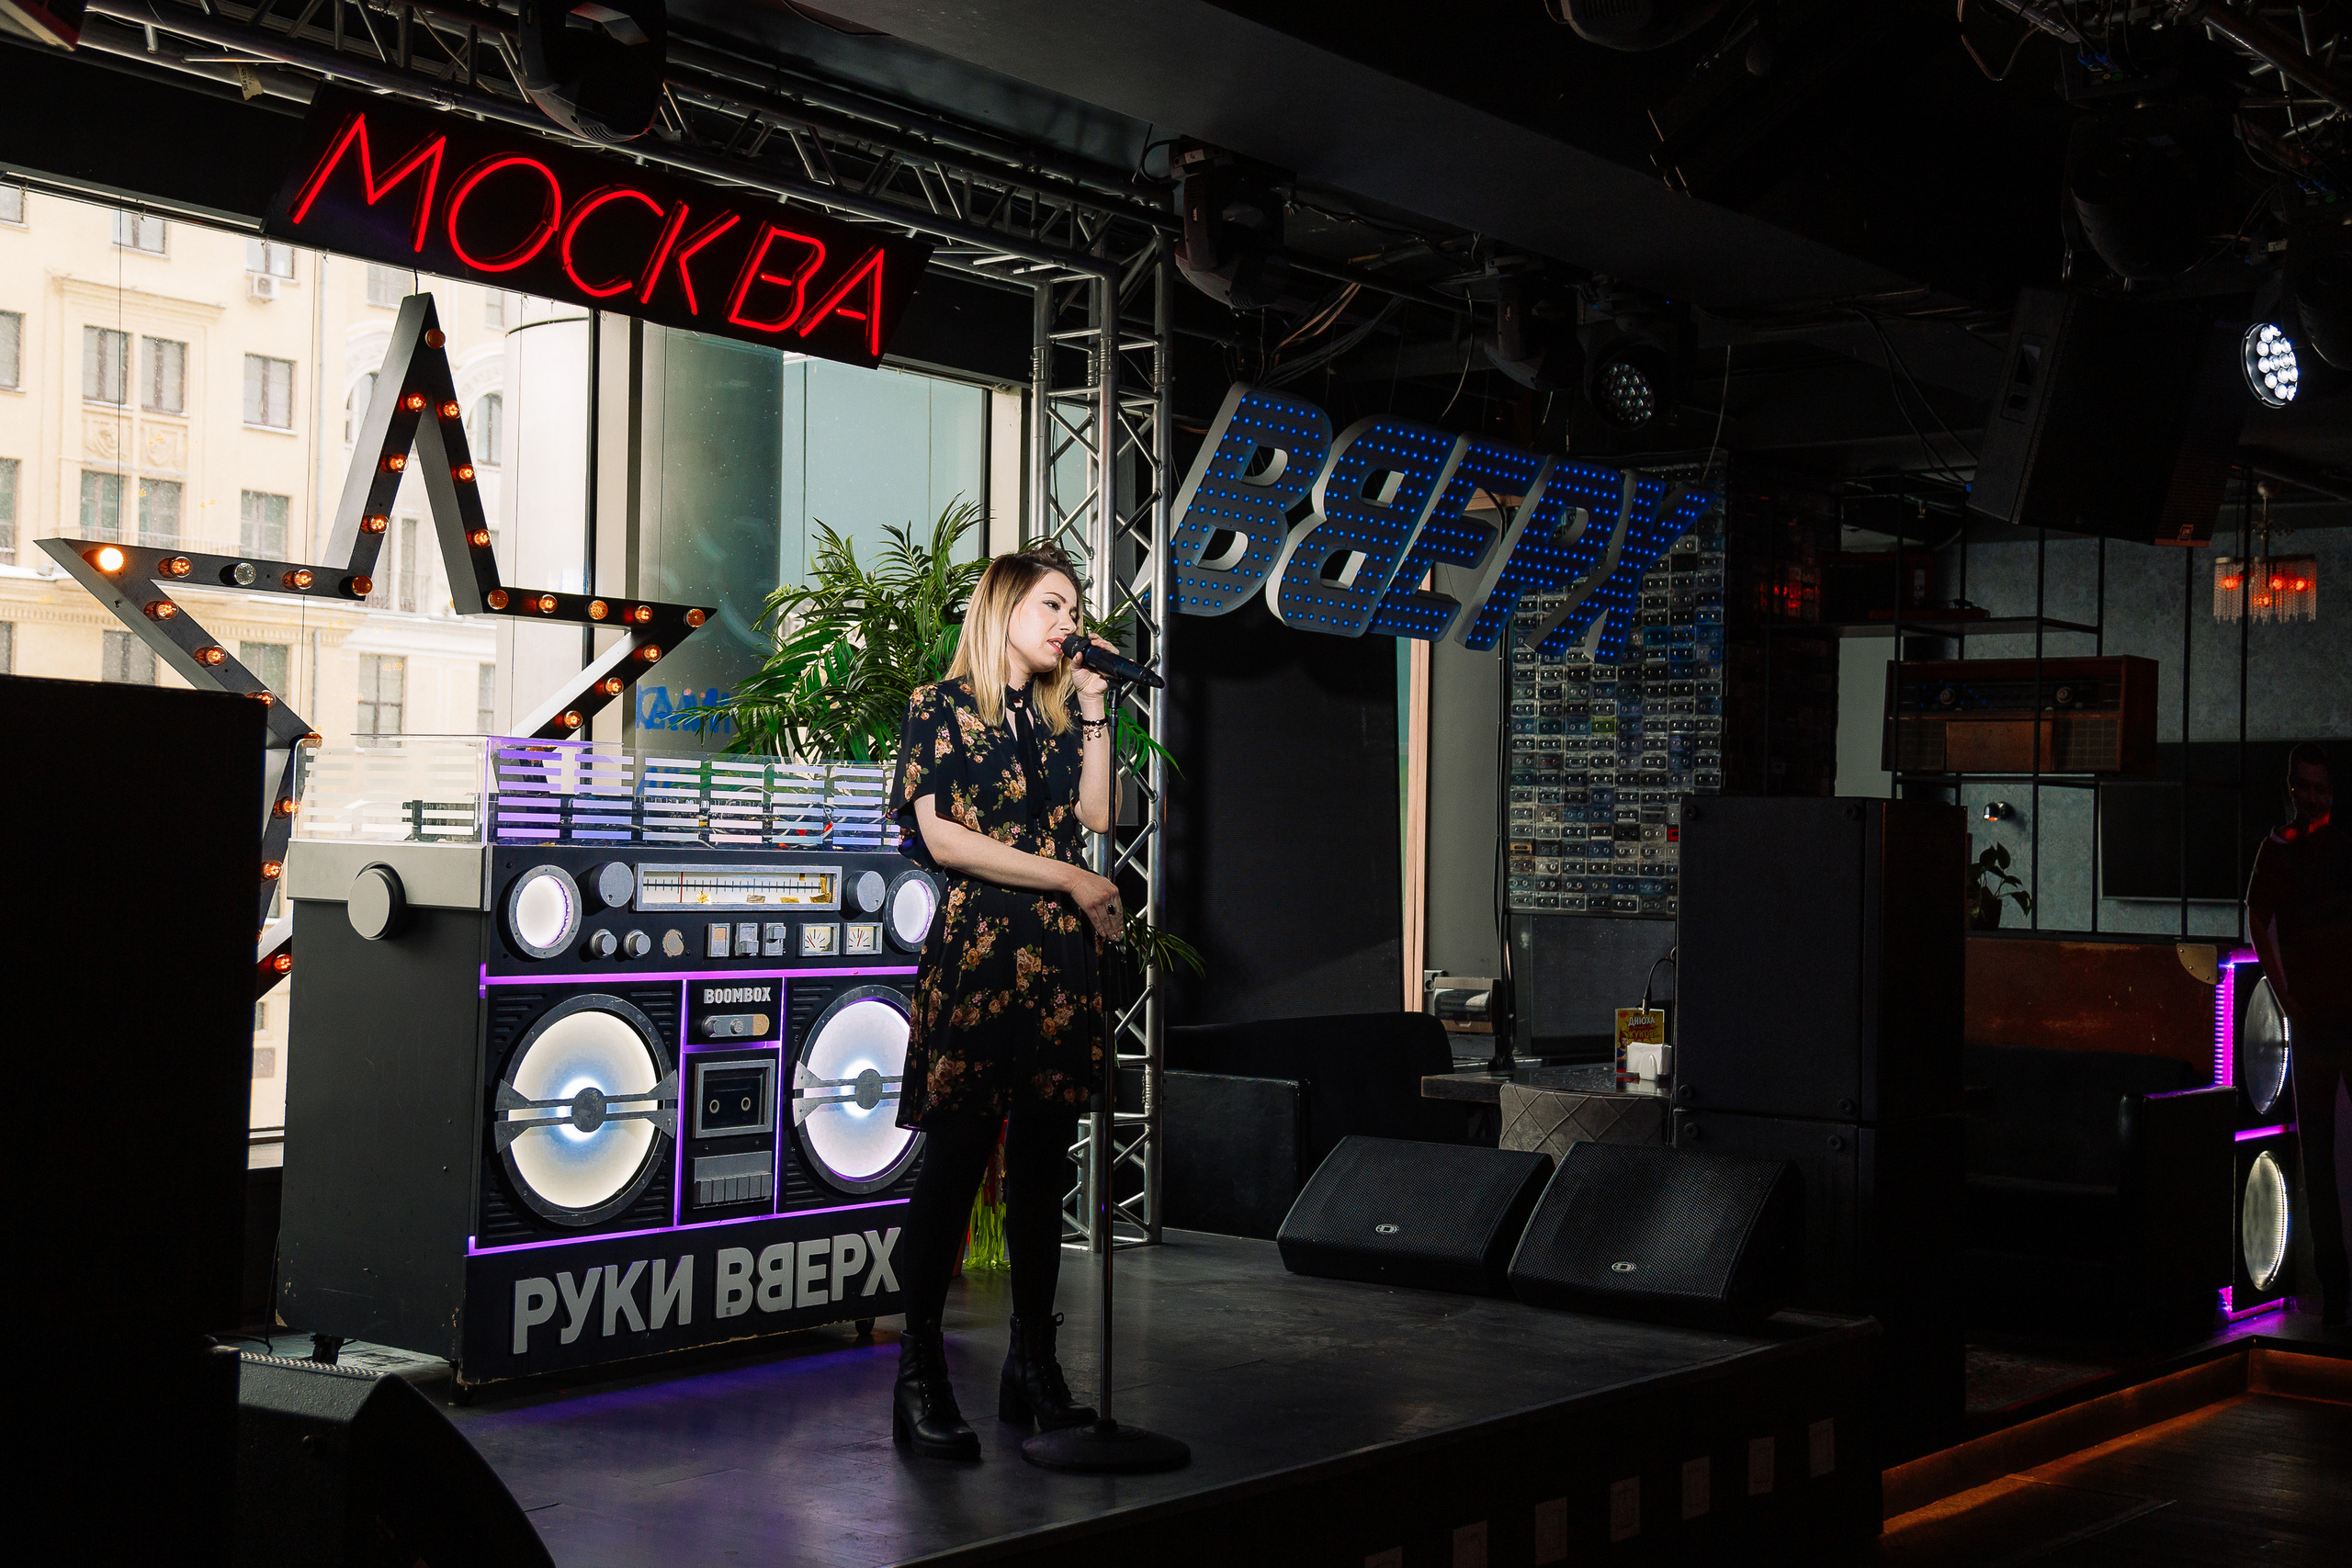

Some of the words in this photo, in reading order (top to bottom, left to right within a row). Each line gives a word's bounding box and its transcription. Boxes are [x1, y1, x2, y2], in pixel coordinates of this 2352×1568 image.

[288, 112, 886, 356] МОСКВА
[703, 987, 772, 1004] BOOMBOX
[1628, 1016, 1656, 1027] ДНЮХА
[512, 1254, 695, 1355] РУКИ
[715, 1226, 902, 1320] ВВЕРХ
